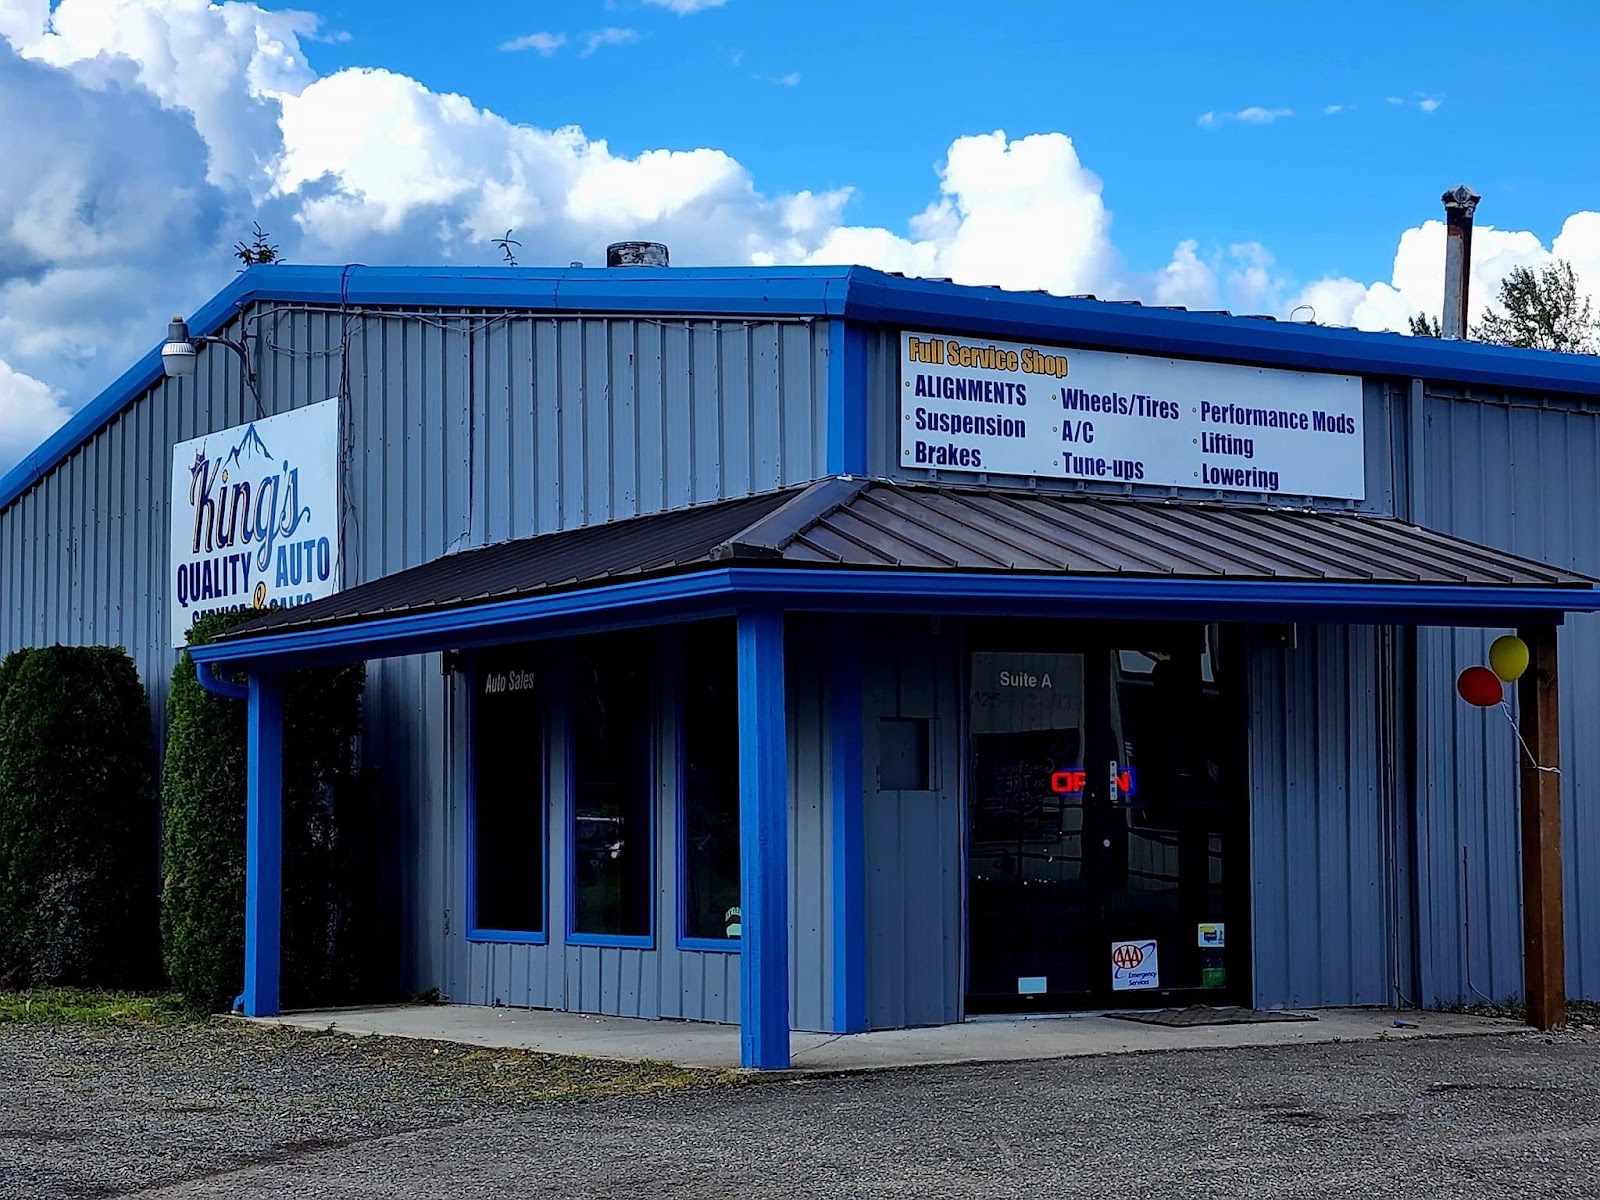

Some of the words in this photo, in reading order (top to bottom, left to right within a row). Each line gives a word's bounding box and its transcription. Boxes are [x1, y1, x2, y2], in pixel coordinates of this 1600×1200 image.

[908, 337, 944, 364] Full
[947, 341, 1018, 372] Service
[1021, 349, 1068, 379] Shop
[915, 375, 1026, 406] ALIGNMENTS
[1061, 387, 1179, 420] Wheels/Tires
[915, 407, 1026, 438] Suspension
[1062, 420, 1094, 443] A/C
[1201, 401, 1308, 430] Performance
[1312, 410, 1355, 434] Mods
[915, 441, 981, 468] Brakes
[1202, 432, 1254, 459] Lifting
[1062, 452, 1144, 480] Tune-ups
[1202, 463, 1279, 491] Lowering
[189, 456, 311, 572] King's
[177, 551, 252, 607] QUALITY
[275, 536, 330, 588] AUTO
[485, 672, 506, 694] Auto
[508, 669, 534, 691] Sales
[1000, 671, 1037, 688] Suite
[1041, 673, 1052, 688] A
[1115, 945, 1142, 968] AAA
[1128, 971, 1157, 979] Emergency
[1128, 979, 1149, 987] Services
